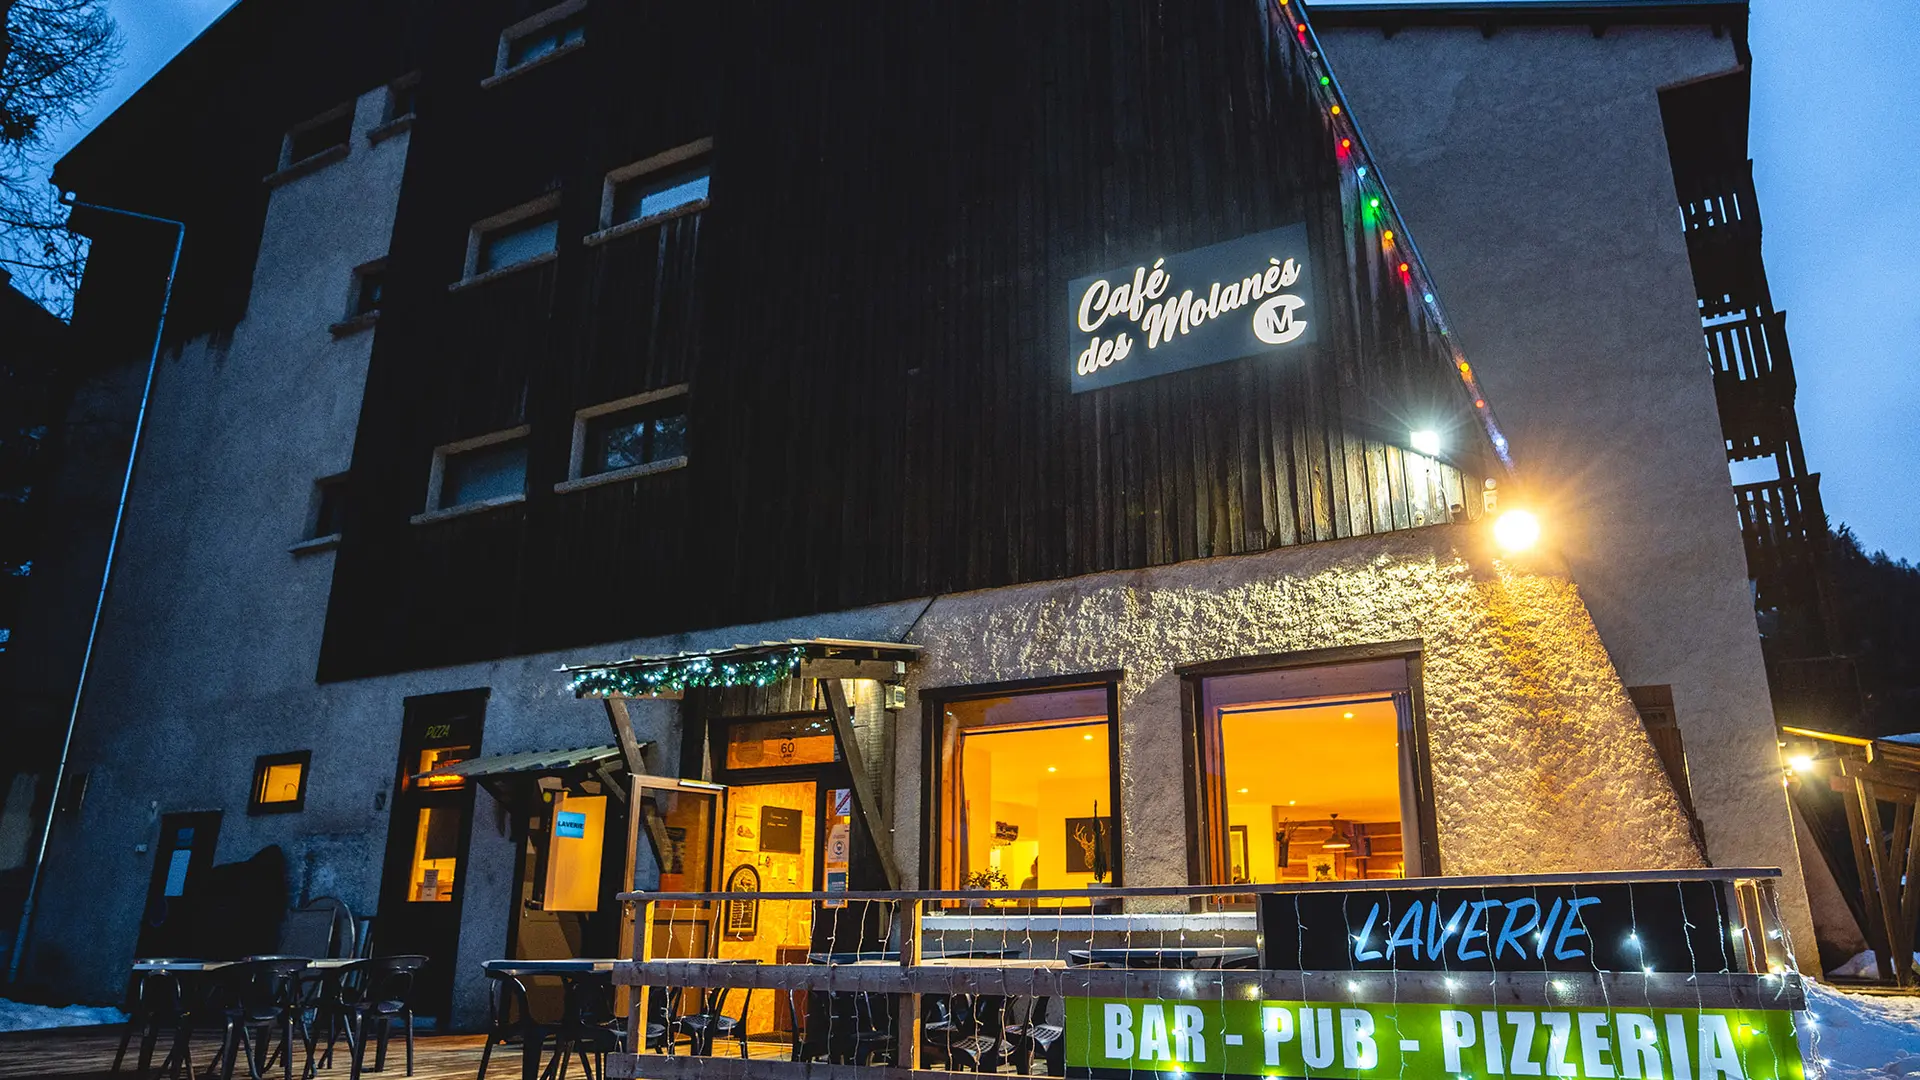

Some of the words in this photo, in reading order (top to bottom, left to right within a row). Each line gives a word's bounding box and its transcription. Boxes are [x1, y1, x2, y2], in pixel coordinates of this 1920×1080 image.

[1077, 333, 1133, 375] des
[1142, 257, 1301, 349] Molanès
[1078, 258, 1170, 332] Café
[425, 725, 450, 738] PIZZA
[781, 742, 795, 753] 60
[557, 820, 584, 829] LAVERIE
[1355, 897, 1601, 961] LAVERIE
[1104, 1003, 1205, 1062] BAR
[1262, 1007, 1378, 1069] PUB
[1440, 1010, 1746, 1080] PIZZERIA
